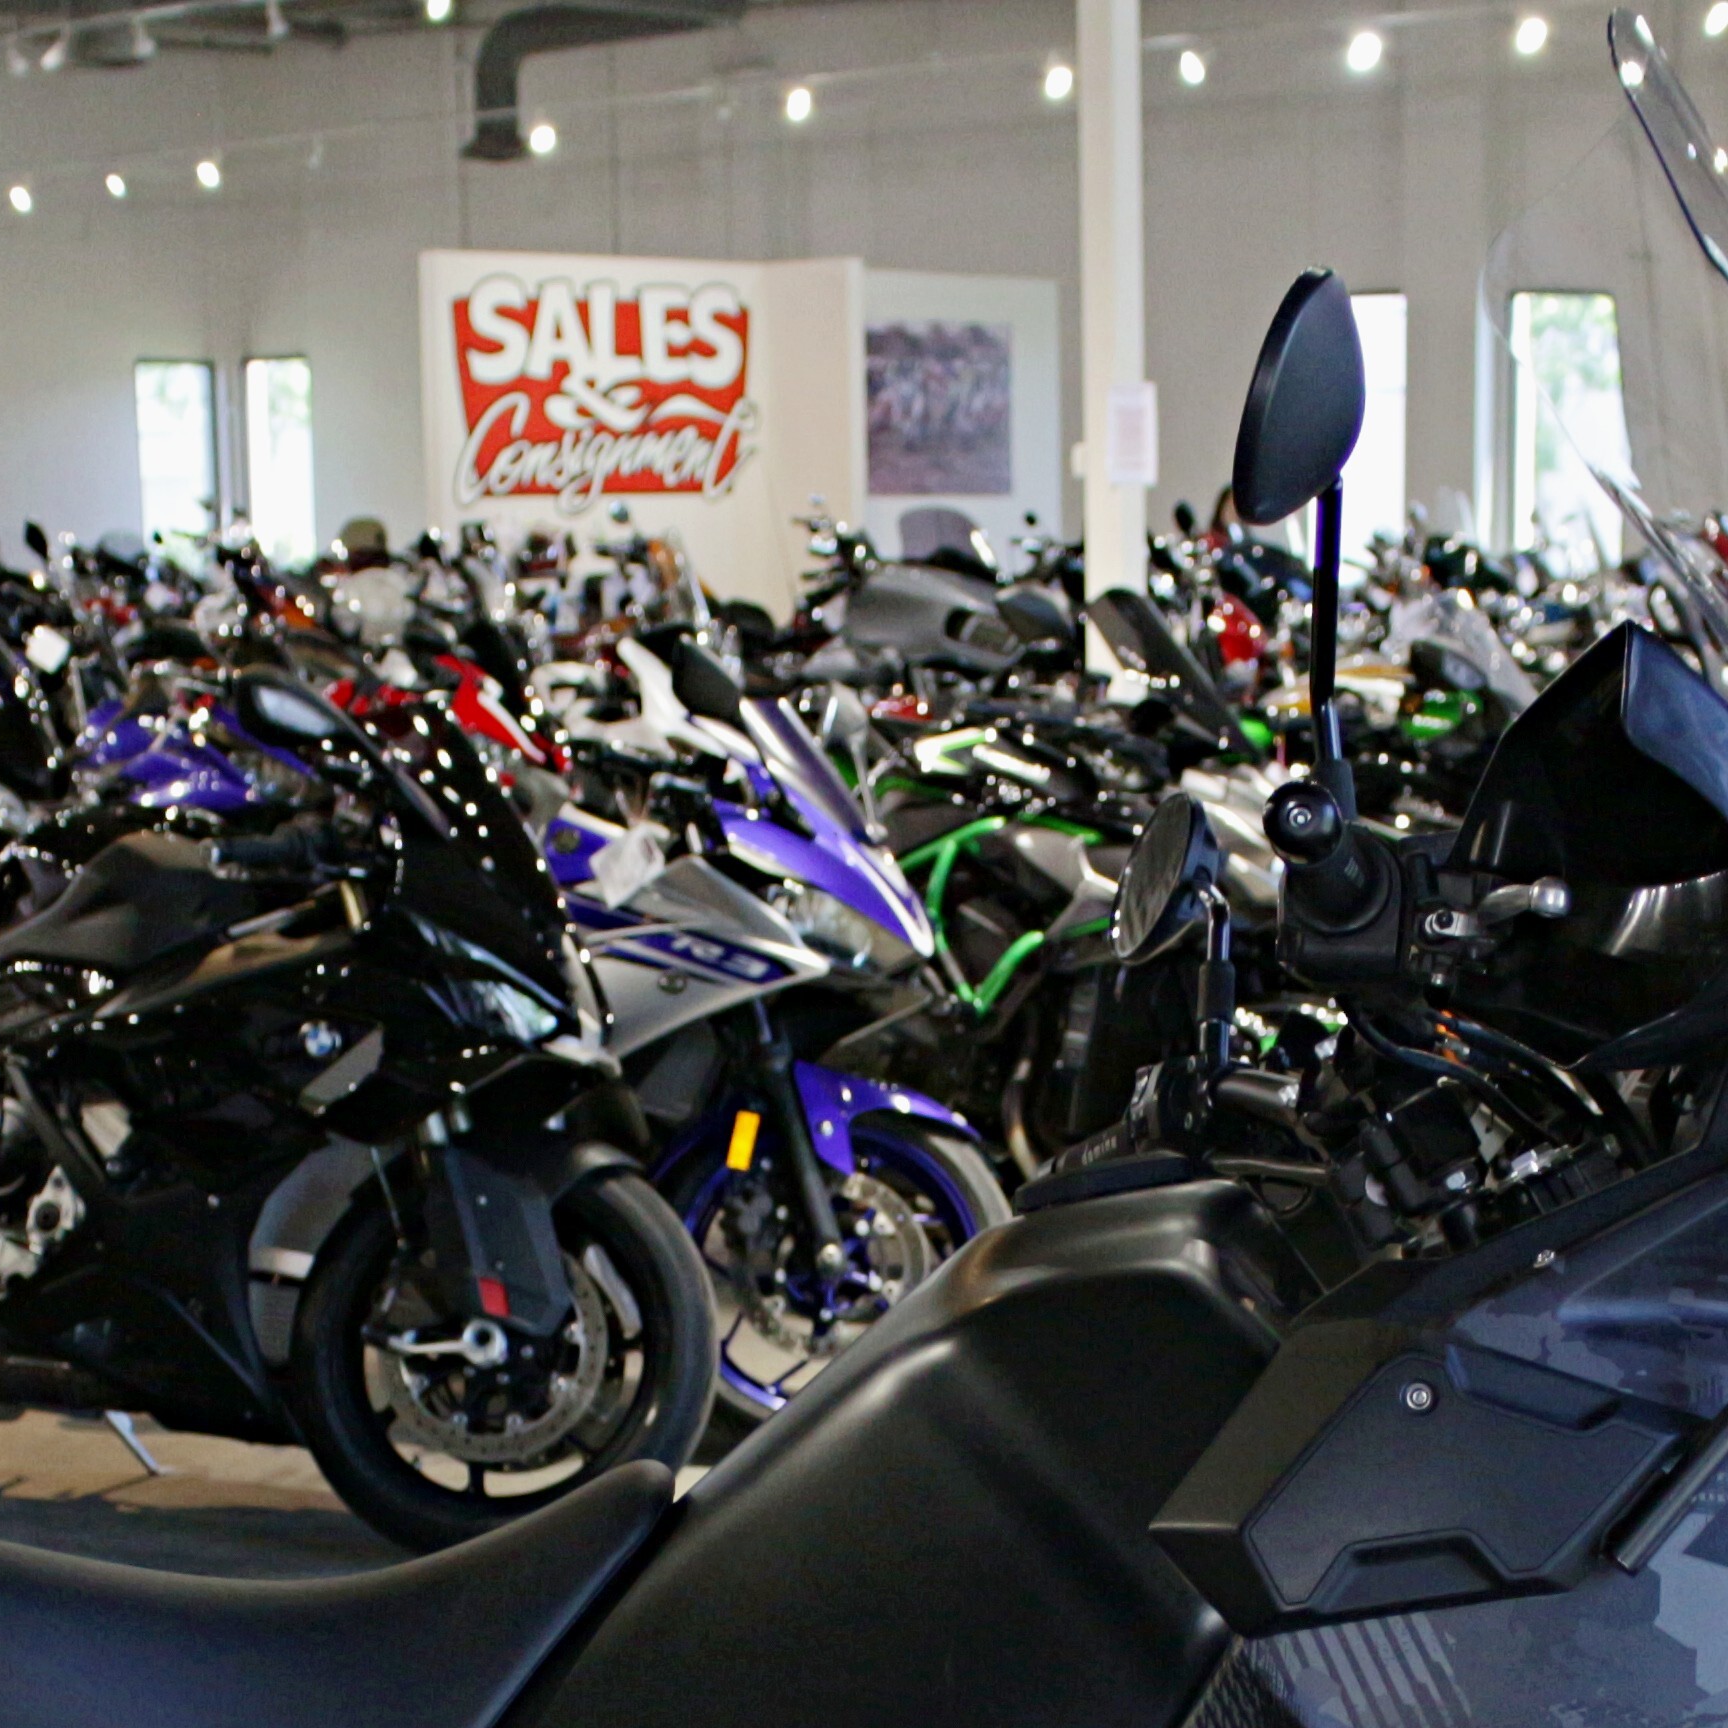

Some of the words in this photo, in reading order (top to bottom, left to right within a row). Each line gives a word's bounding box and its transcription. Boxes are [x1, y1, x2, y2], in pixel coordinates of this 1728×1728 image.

[465, 272, 748, 390] SALES
[453, 389, 760, 517] Consignment
[542, 364, 652, 432] &
